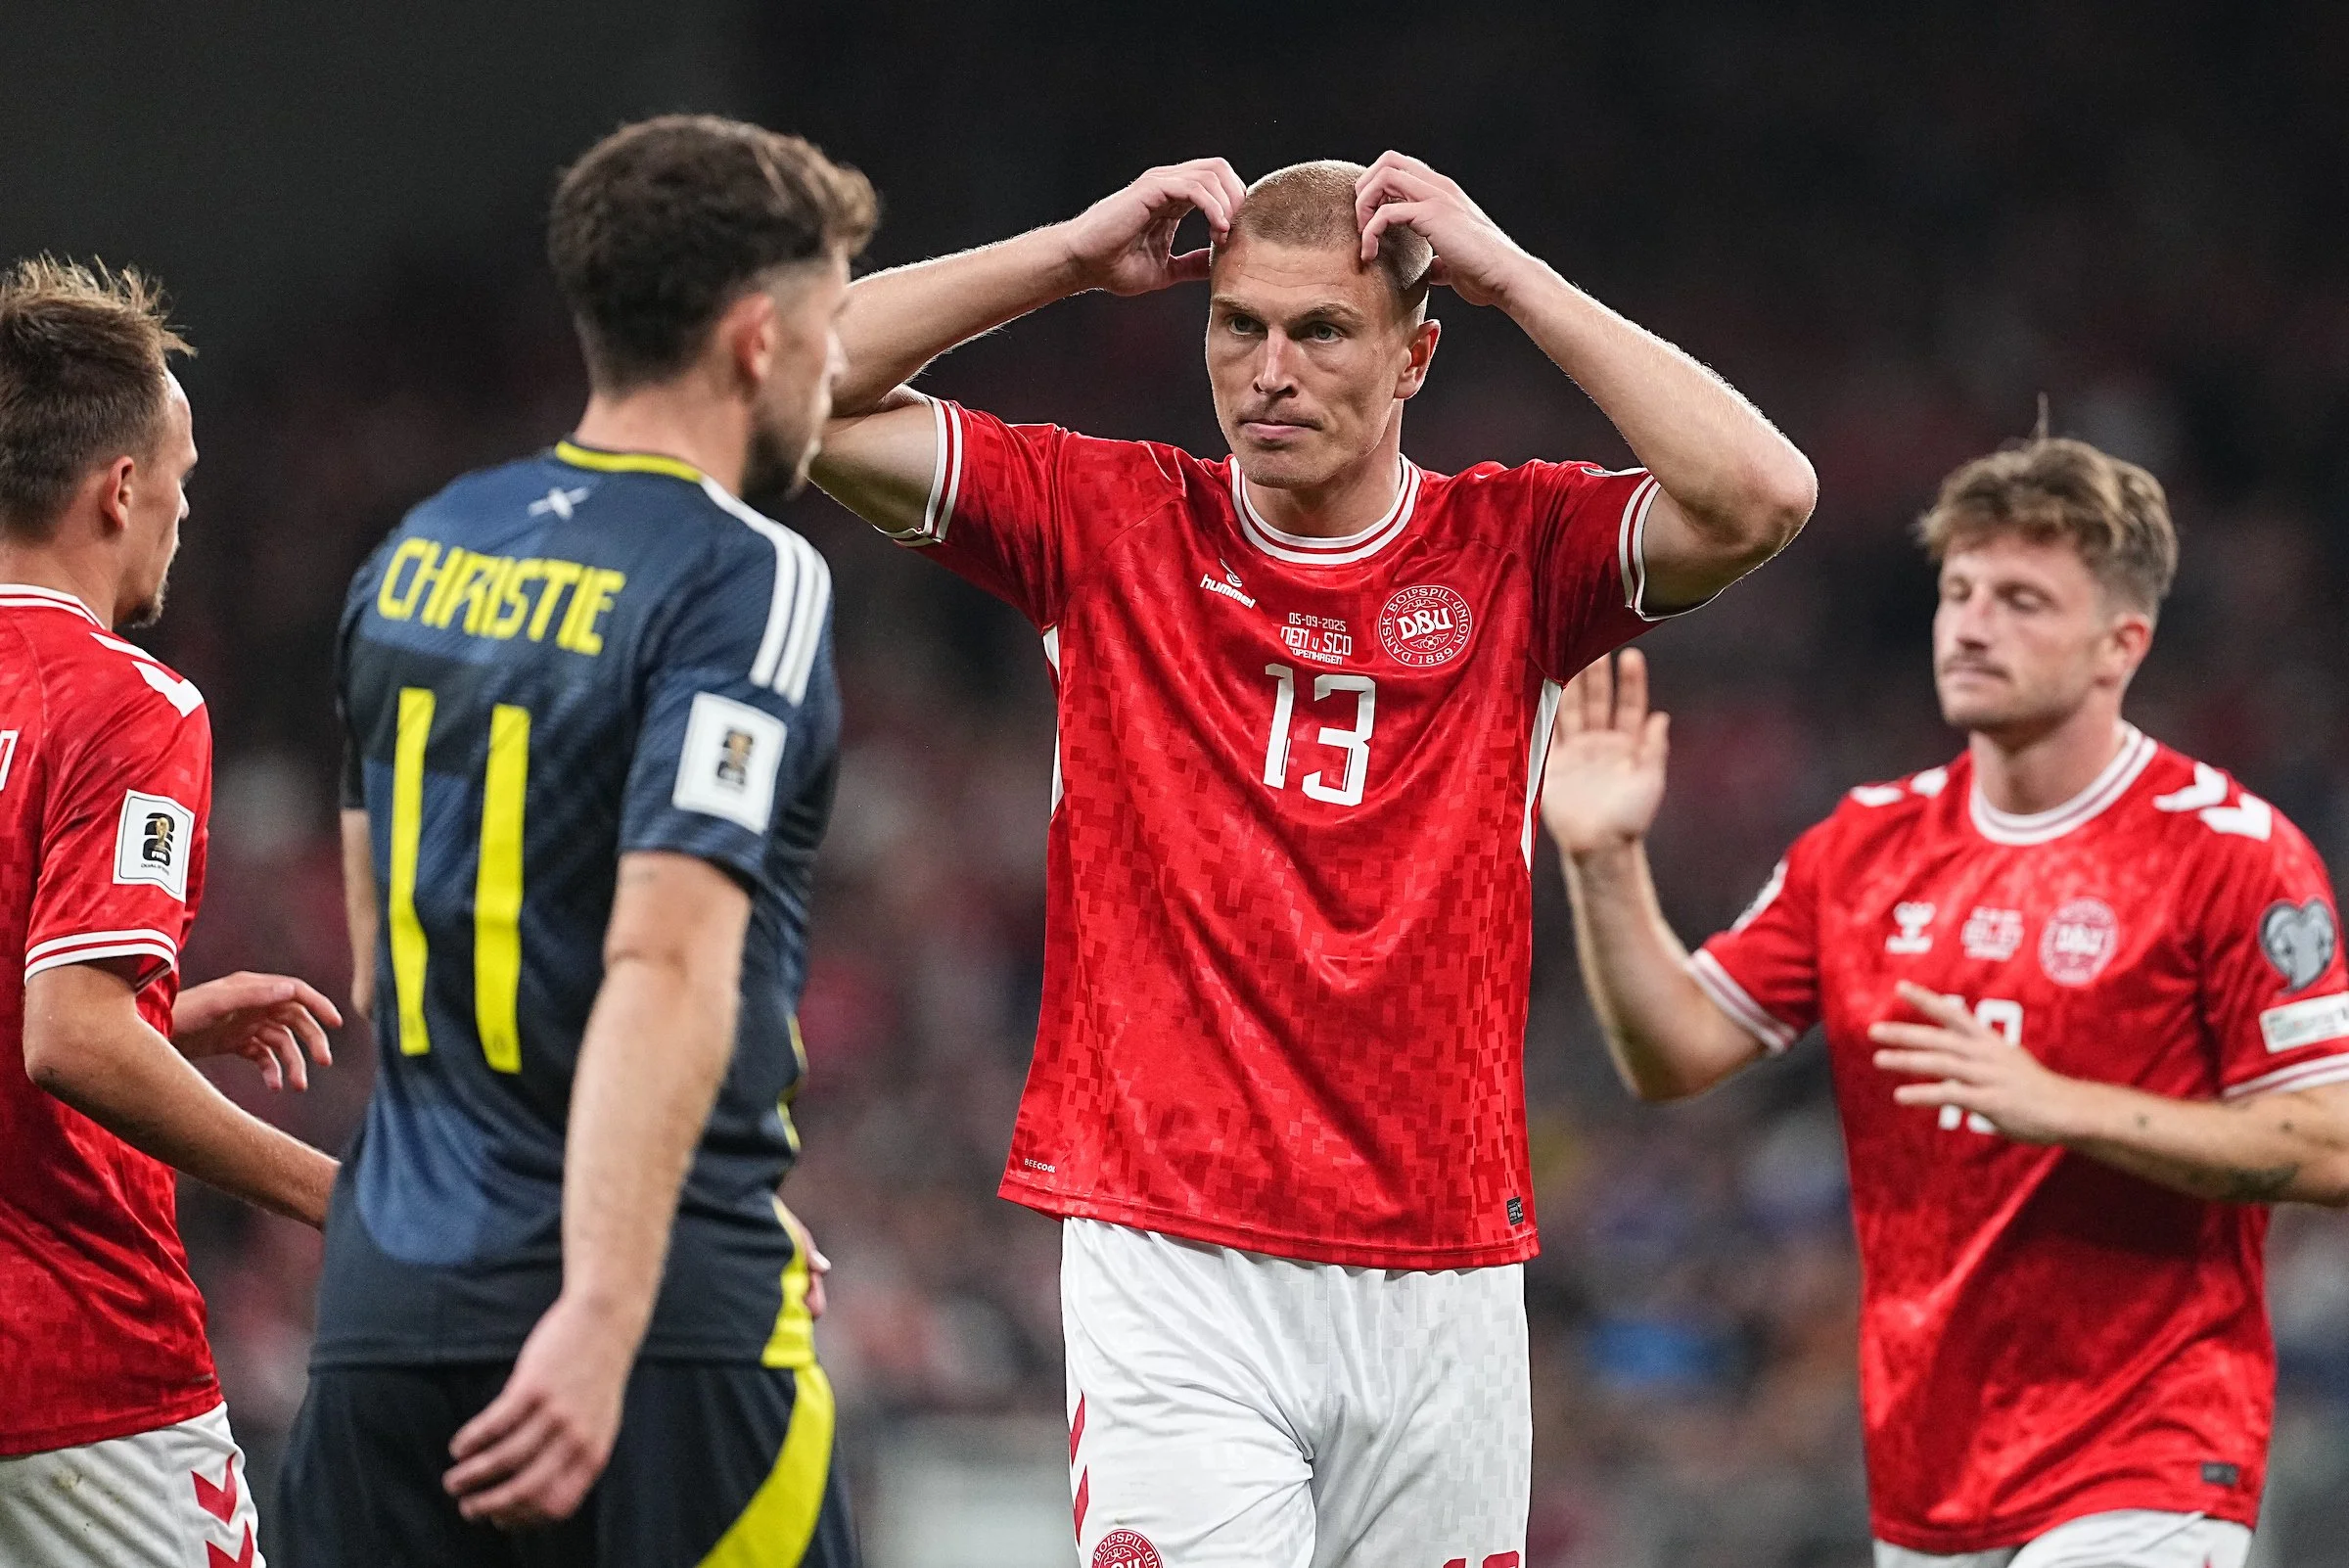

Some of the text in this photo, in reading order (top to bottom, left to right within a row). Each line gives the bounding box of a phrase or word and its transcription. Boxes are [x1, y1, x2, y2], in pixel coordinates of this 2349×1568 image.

[377, 537, 626, 657] CHRISTIE
[1199, 573, 1257, 609] hummel
[1289, 612, 1347, 632] 05-09-2025
[1397, 607, 1454, 640] DBU
[1289, 646, 1343, 666] OPENHAGEN
[1322, 631, 1352, 657] SCO
[1381, 616, 1412, 663] DANSK
[1417, 647, 1453, 665] 1889
[1263, 663, 1376, 807] 13
[389, 687, 531, 1074] 11
[1024, 1158, 1056, 1174] BEECOOL
